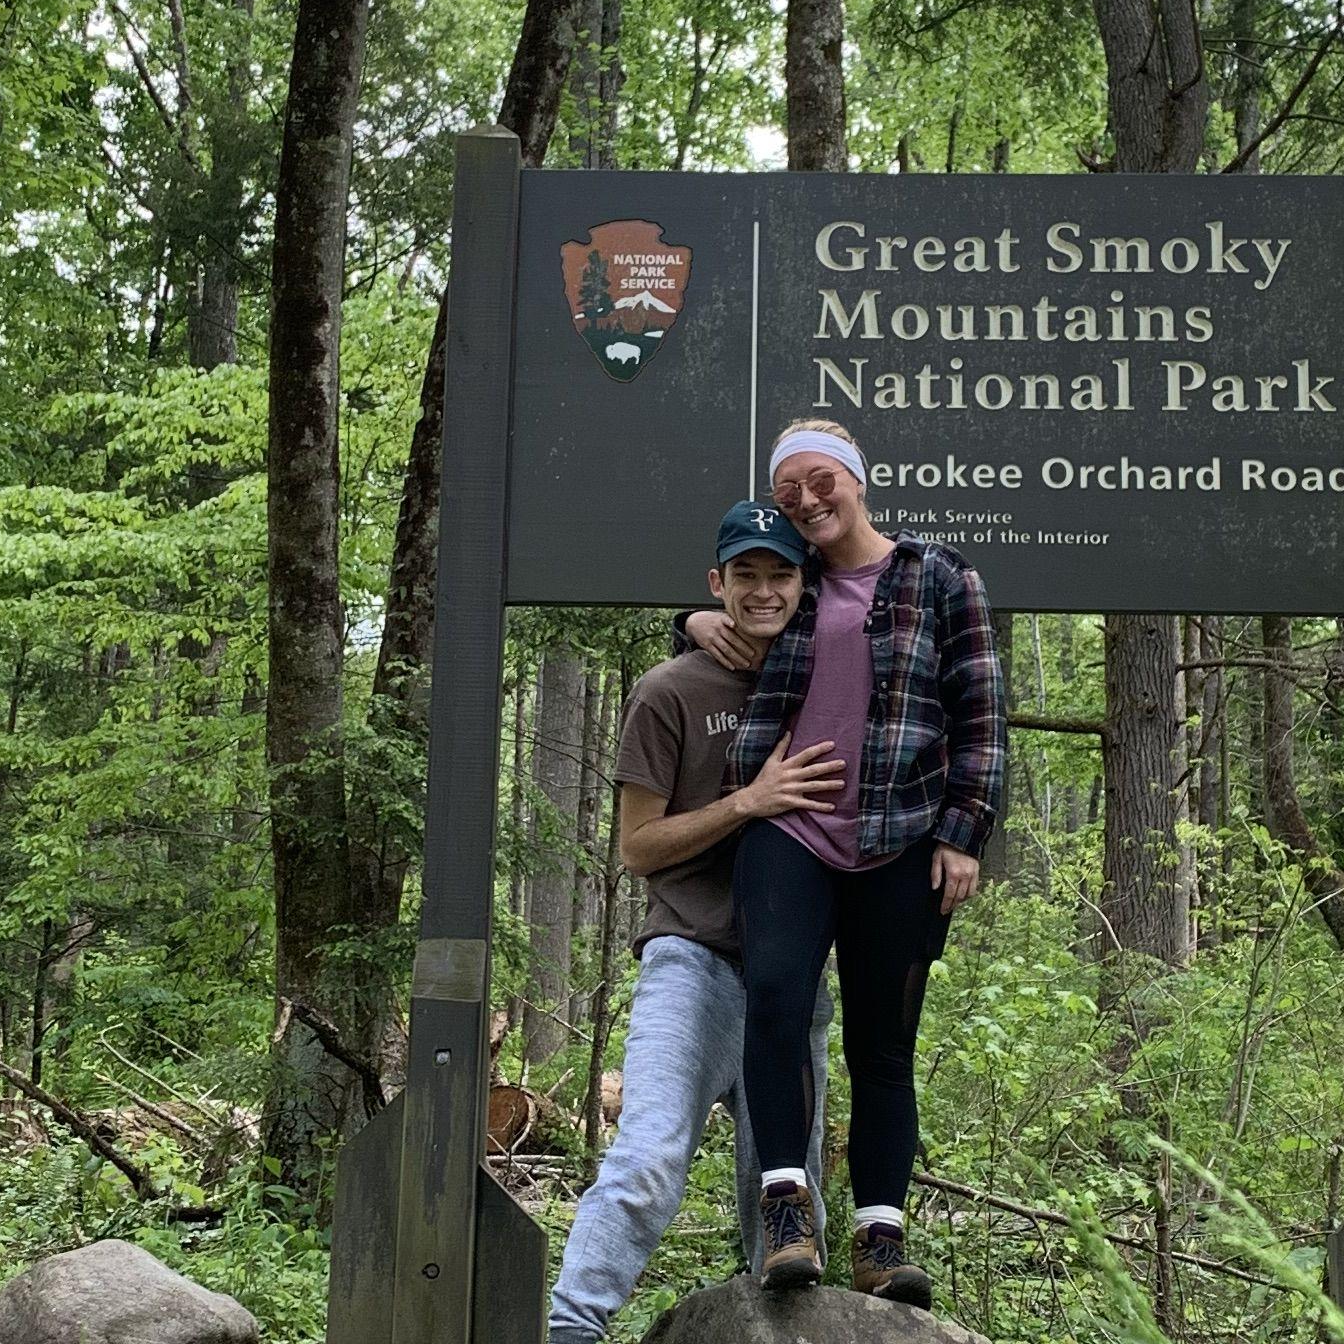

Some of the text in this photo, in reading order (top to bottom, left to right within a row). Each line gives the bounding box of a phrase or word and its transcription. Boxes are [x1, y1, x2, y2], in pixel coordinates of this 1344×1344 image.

[614, 254, 683, 265] NATIONAL
[815, 221, 1292, 290] Great Smoky
[630, 266, 666, 277] PARK
[620, 278, 676, 289] SERVICE
[813, 289, 1214, 343] Mountains
[812, 357, 1337, 412] National Park
[870, 454, 1023, 489] erokee
[1041, 456, 1221, 491] Orchard
[897, 509, 937, 523] Park
[945, 509, 1012, 524] Service
[973, 529, 992, 543] of
[1000, 529, 1031, 544] the
[1038, 530, 1110, 545] Interior
